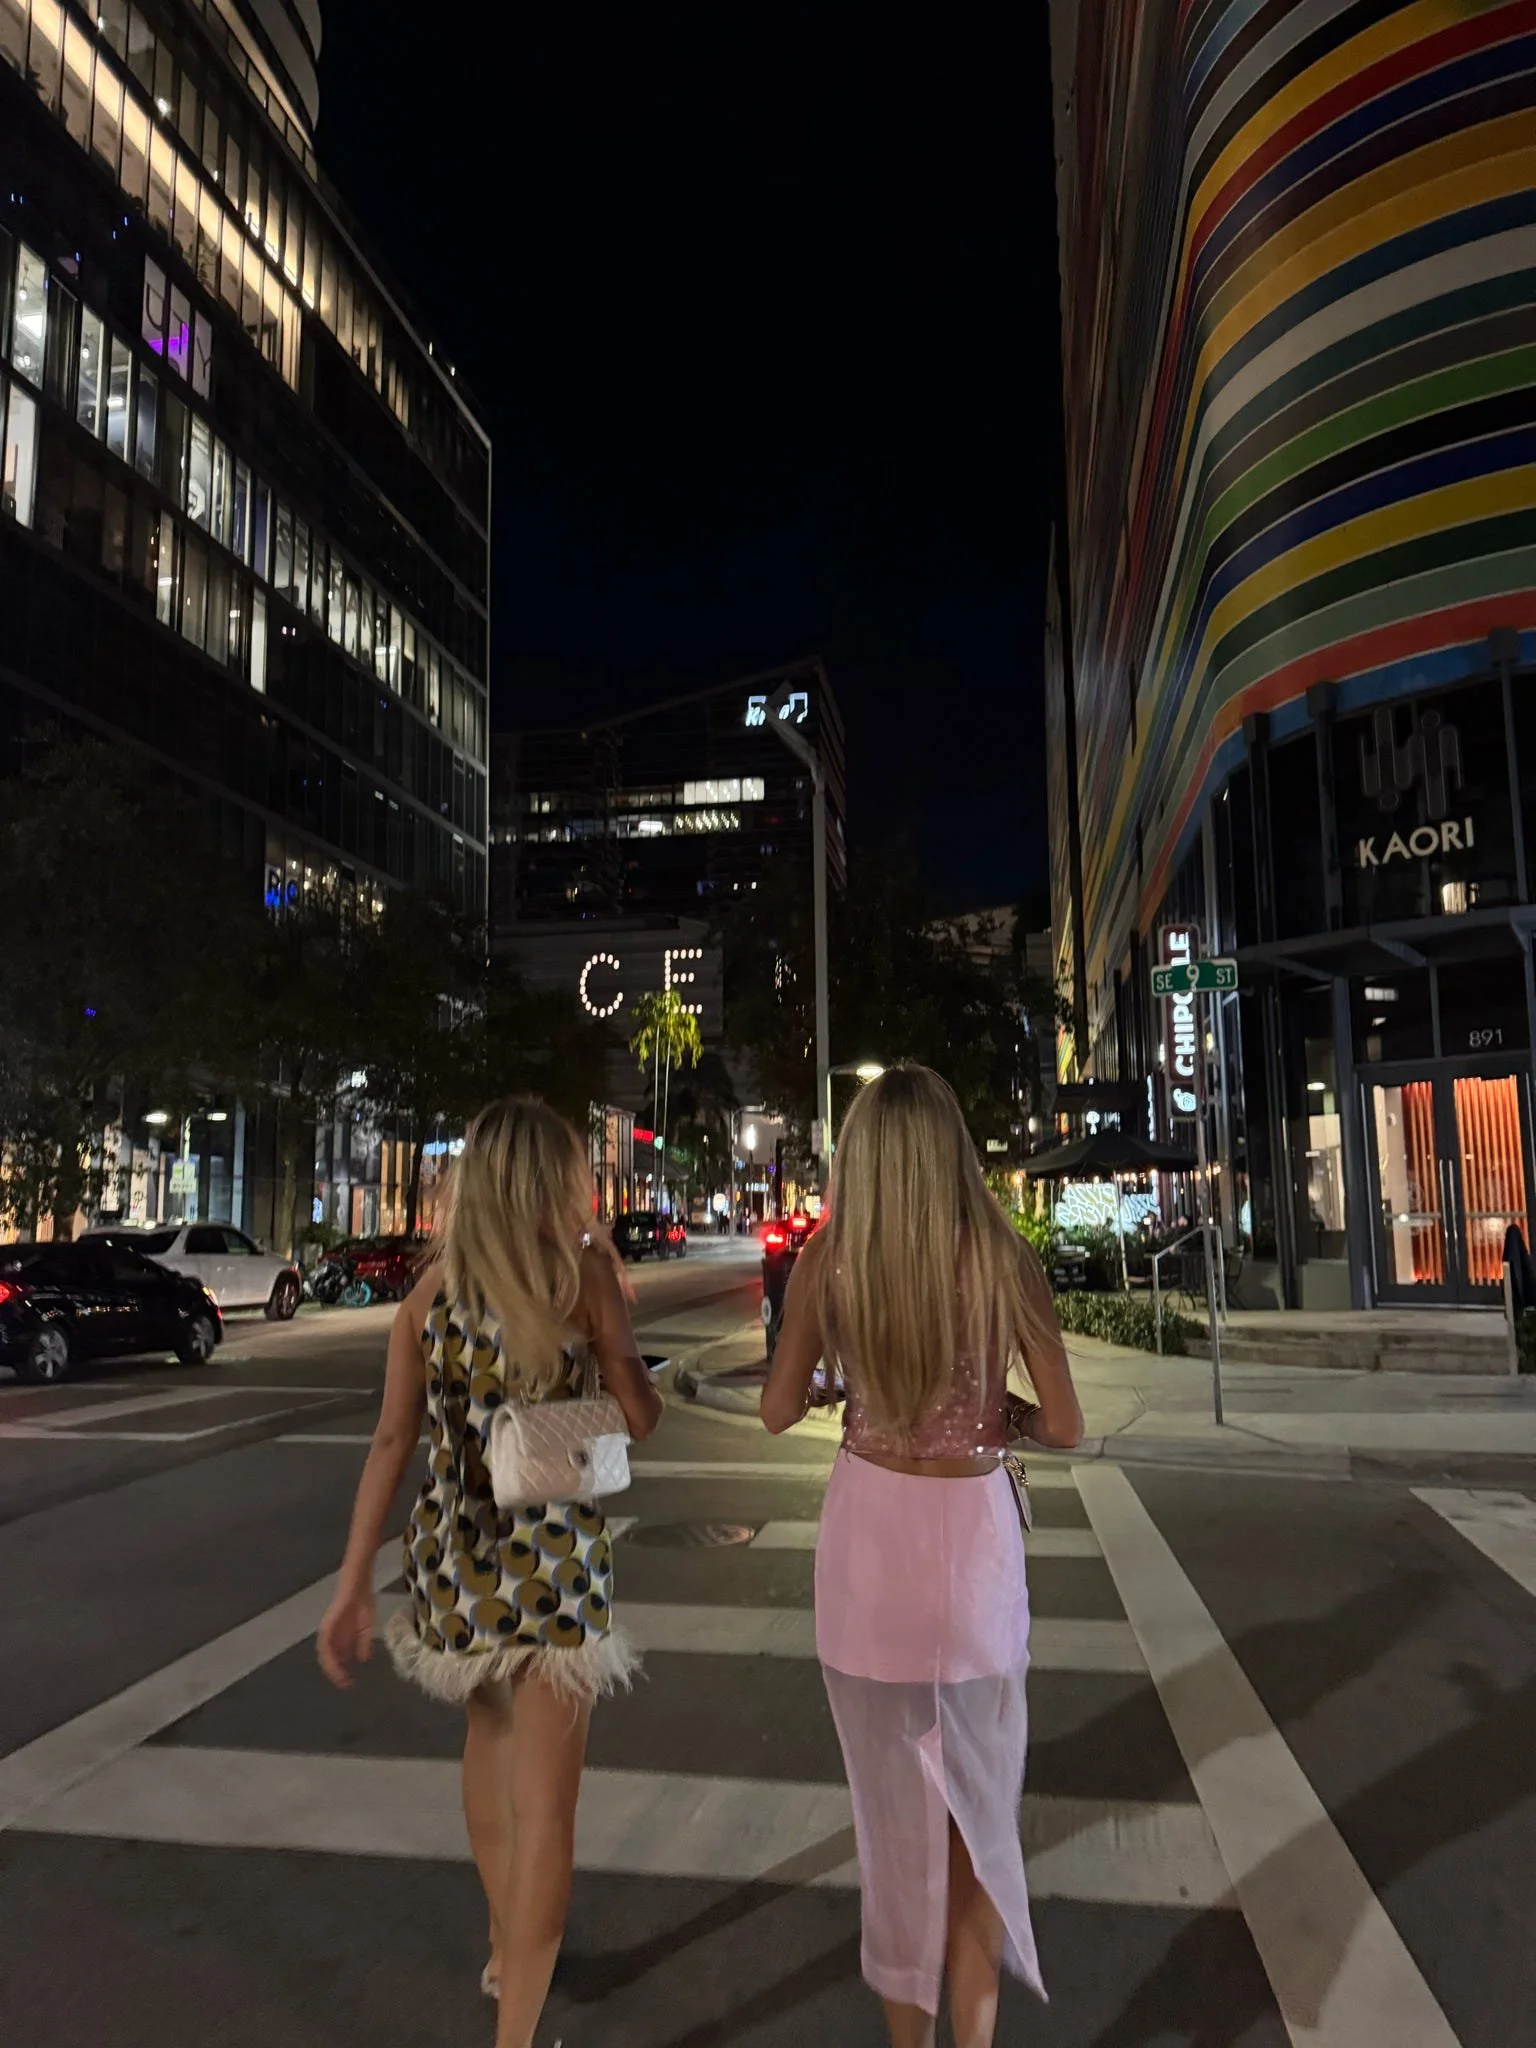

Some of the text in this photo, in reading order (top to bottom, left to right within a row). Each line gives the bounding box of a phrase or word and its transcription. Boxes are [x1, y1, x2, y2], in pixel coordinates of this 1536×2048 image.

[1359, 816, 1475, 869] KAORI
[1156, 964, 1233, 992] SE 9 ST
[1169, 931, 1197, 1077] CHIPOLE
[1469, 1028, 1503, 1048] 891
